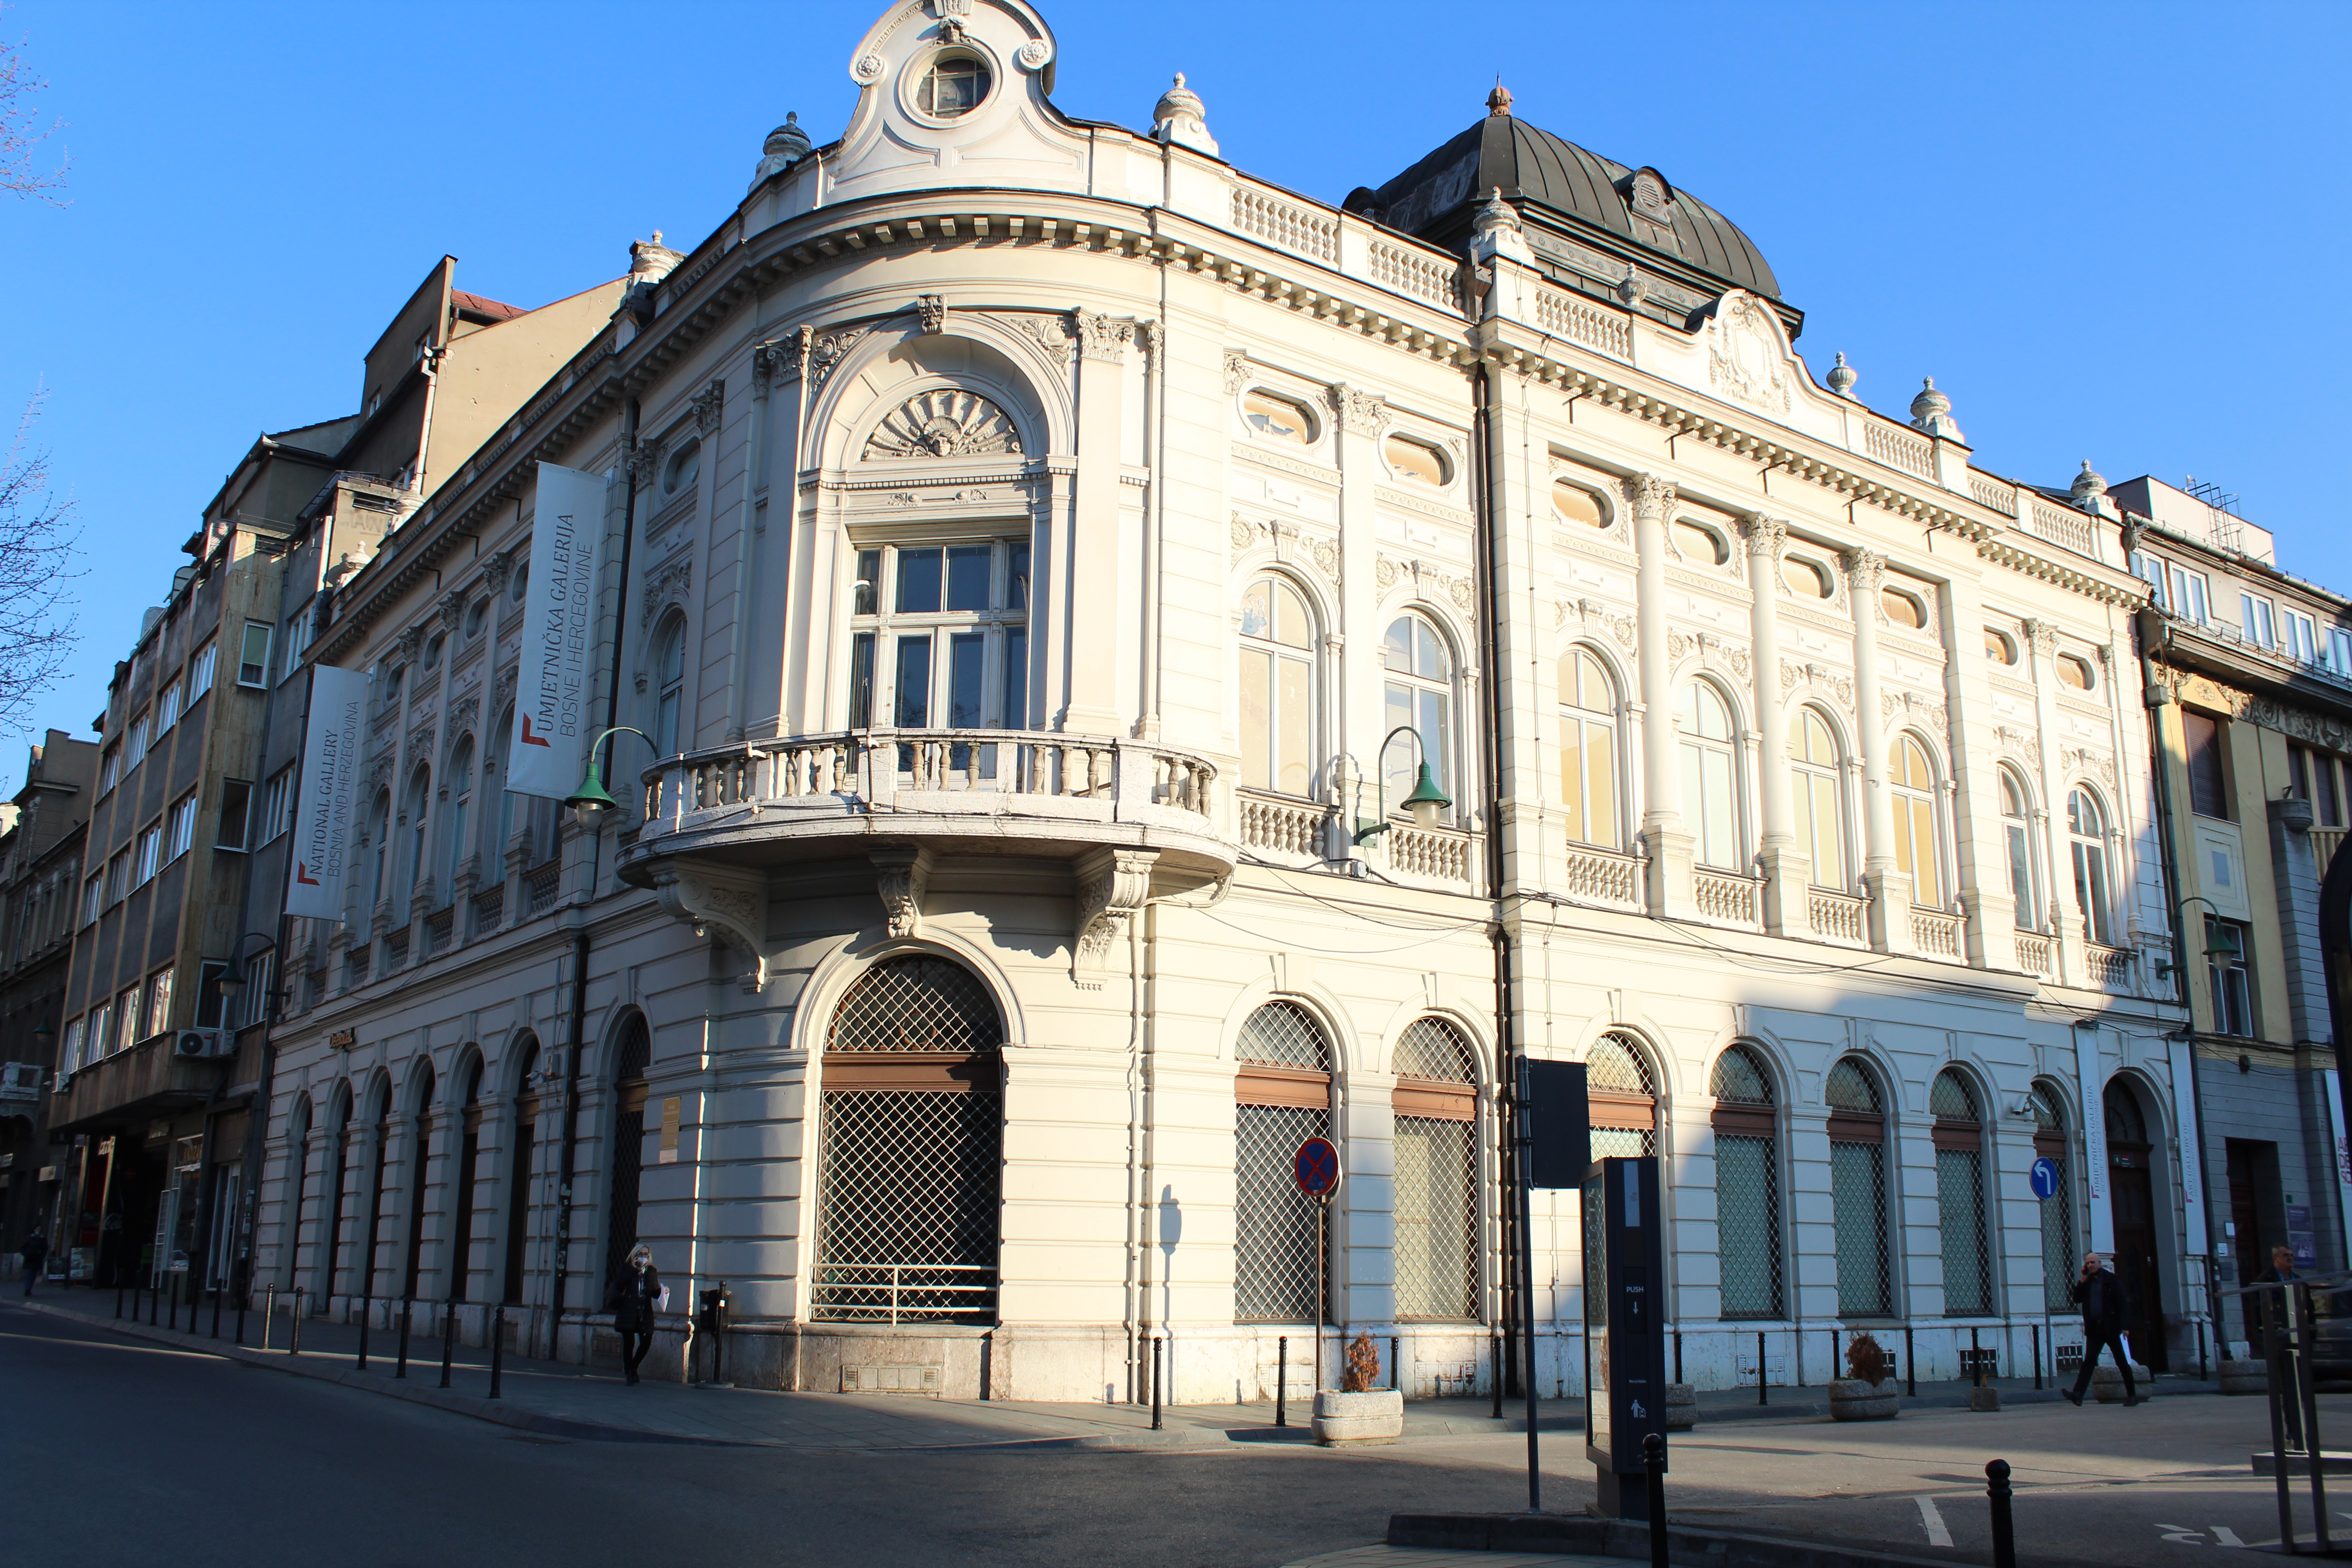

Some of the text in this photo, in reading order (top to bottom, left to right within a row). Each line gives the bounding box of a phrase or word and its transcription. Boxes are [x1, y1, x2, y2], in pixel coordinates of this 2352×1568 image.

[537, 514, 575, 732] UMJETNIČKA GALERIJA
[566, 542, 593, 663] HERCEGOVINE
[559, 675, 580, 737] BOSNE
[309, 729, 338, 875] NATIONAL GALLERY
[327, 701, 359, 877] BOSNIA AND HERZEGOVINA
[2087, 1085, 2095, 1128] GALERIJA
[2182, 1122, 2188, 1134] OF
